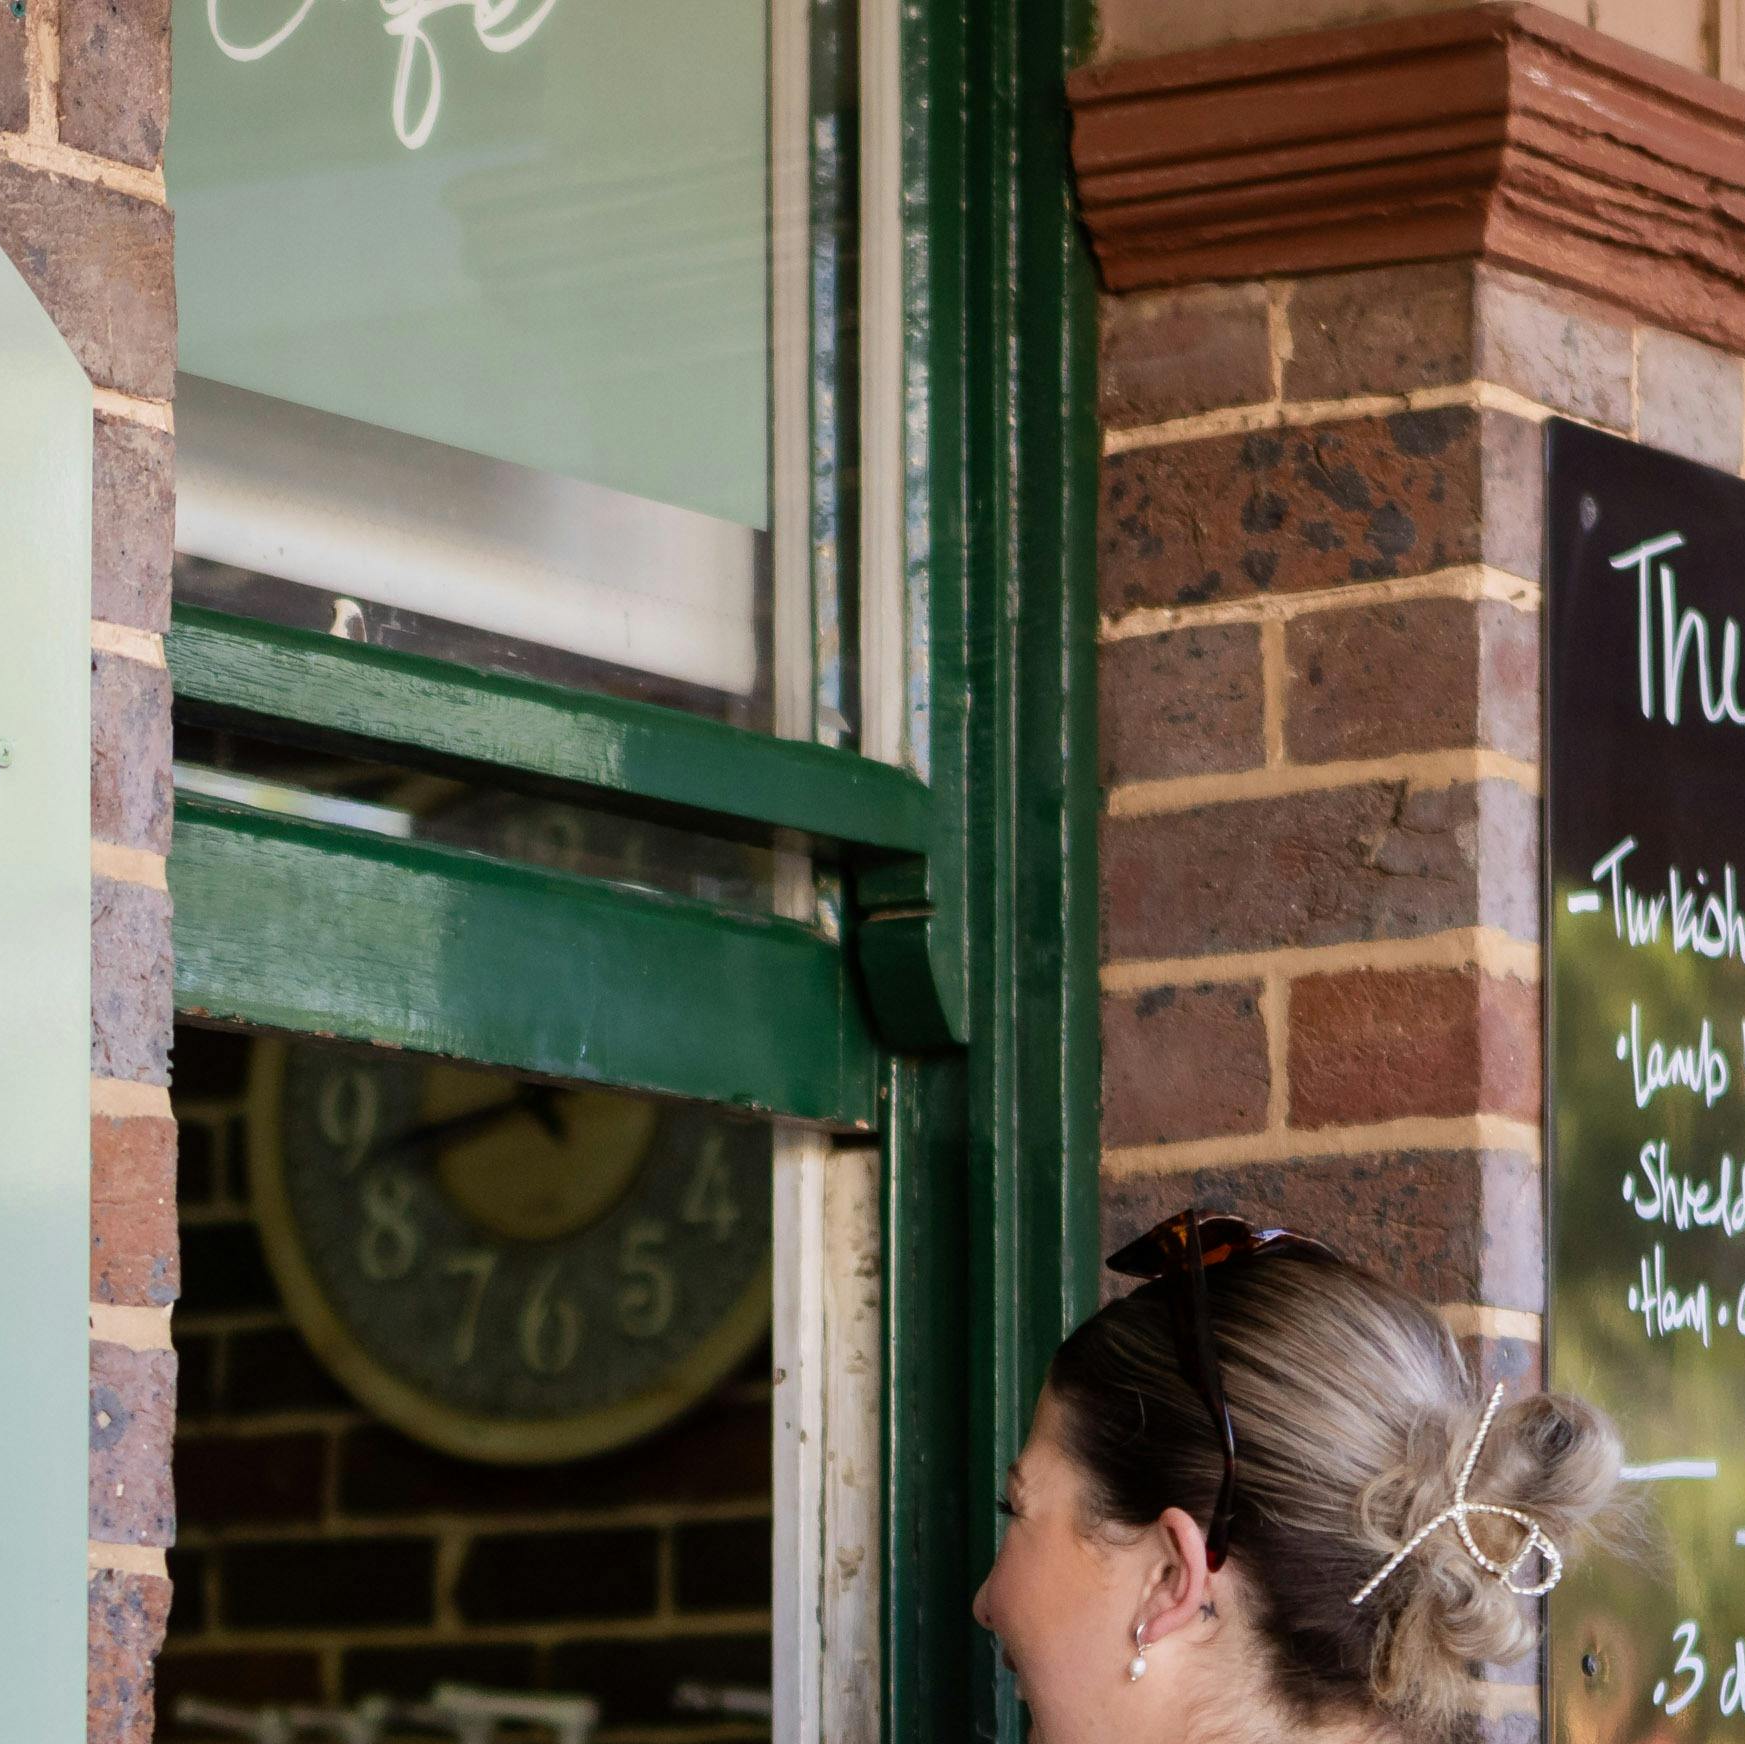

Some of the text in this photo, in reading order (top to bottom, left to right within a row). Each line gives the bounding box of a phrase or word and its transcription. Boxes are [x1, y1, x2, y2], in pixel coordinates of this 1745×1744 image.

[1631, 1003, 1728, 1110] Lamb
[362, 1168, 418, 1281] 8
[682, 1134, 740, 1241] 4
[446, 1247, 499, 1366] 7
[519, 1268, 583, 1373] 6
[619, 1221, 676, 1338] 5
[1639, 1244, 1710, 1349] Ham
[1664, 1619, 1705, 1717] 3
